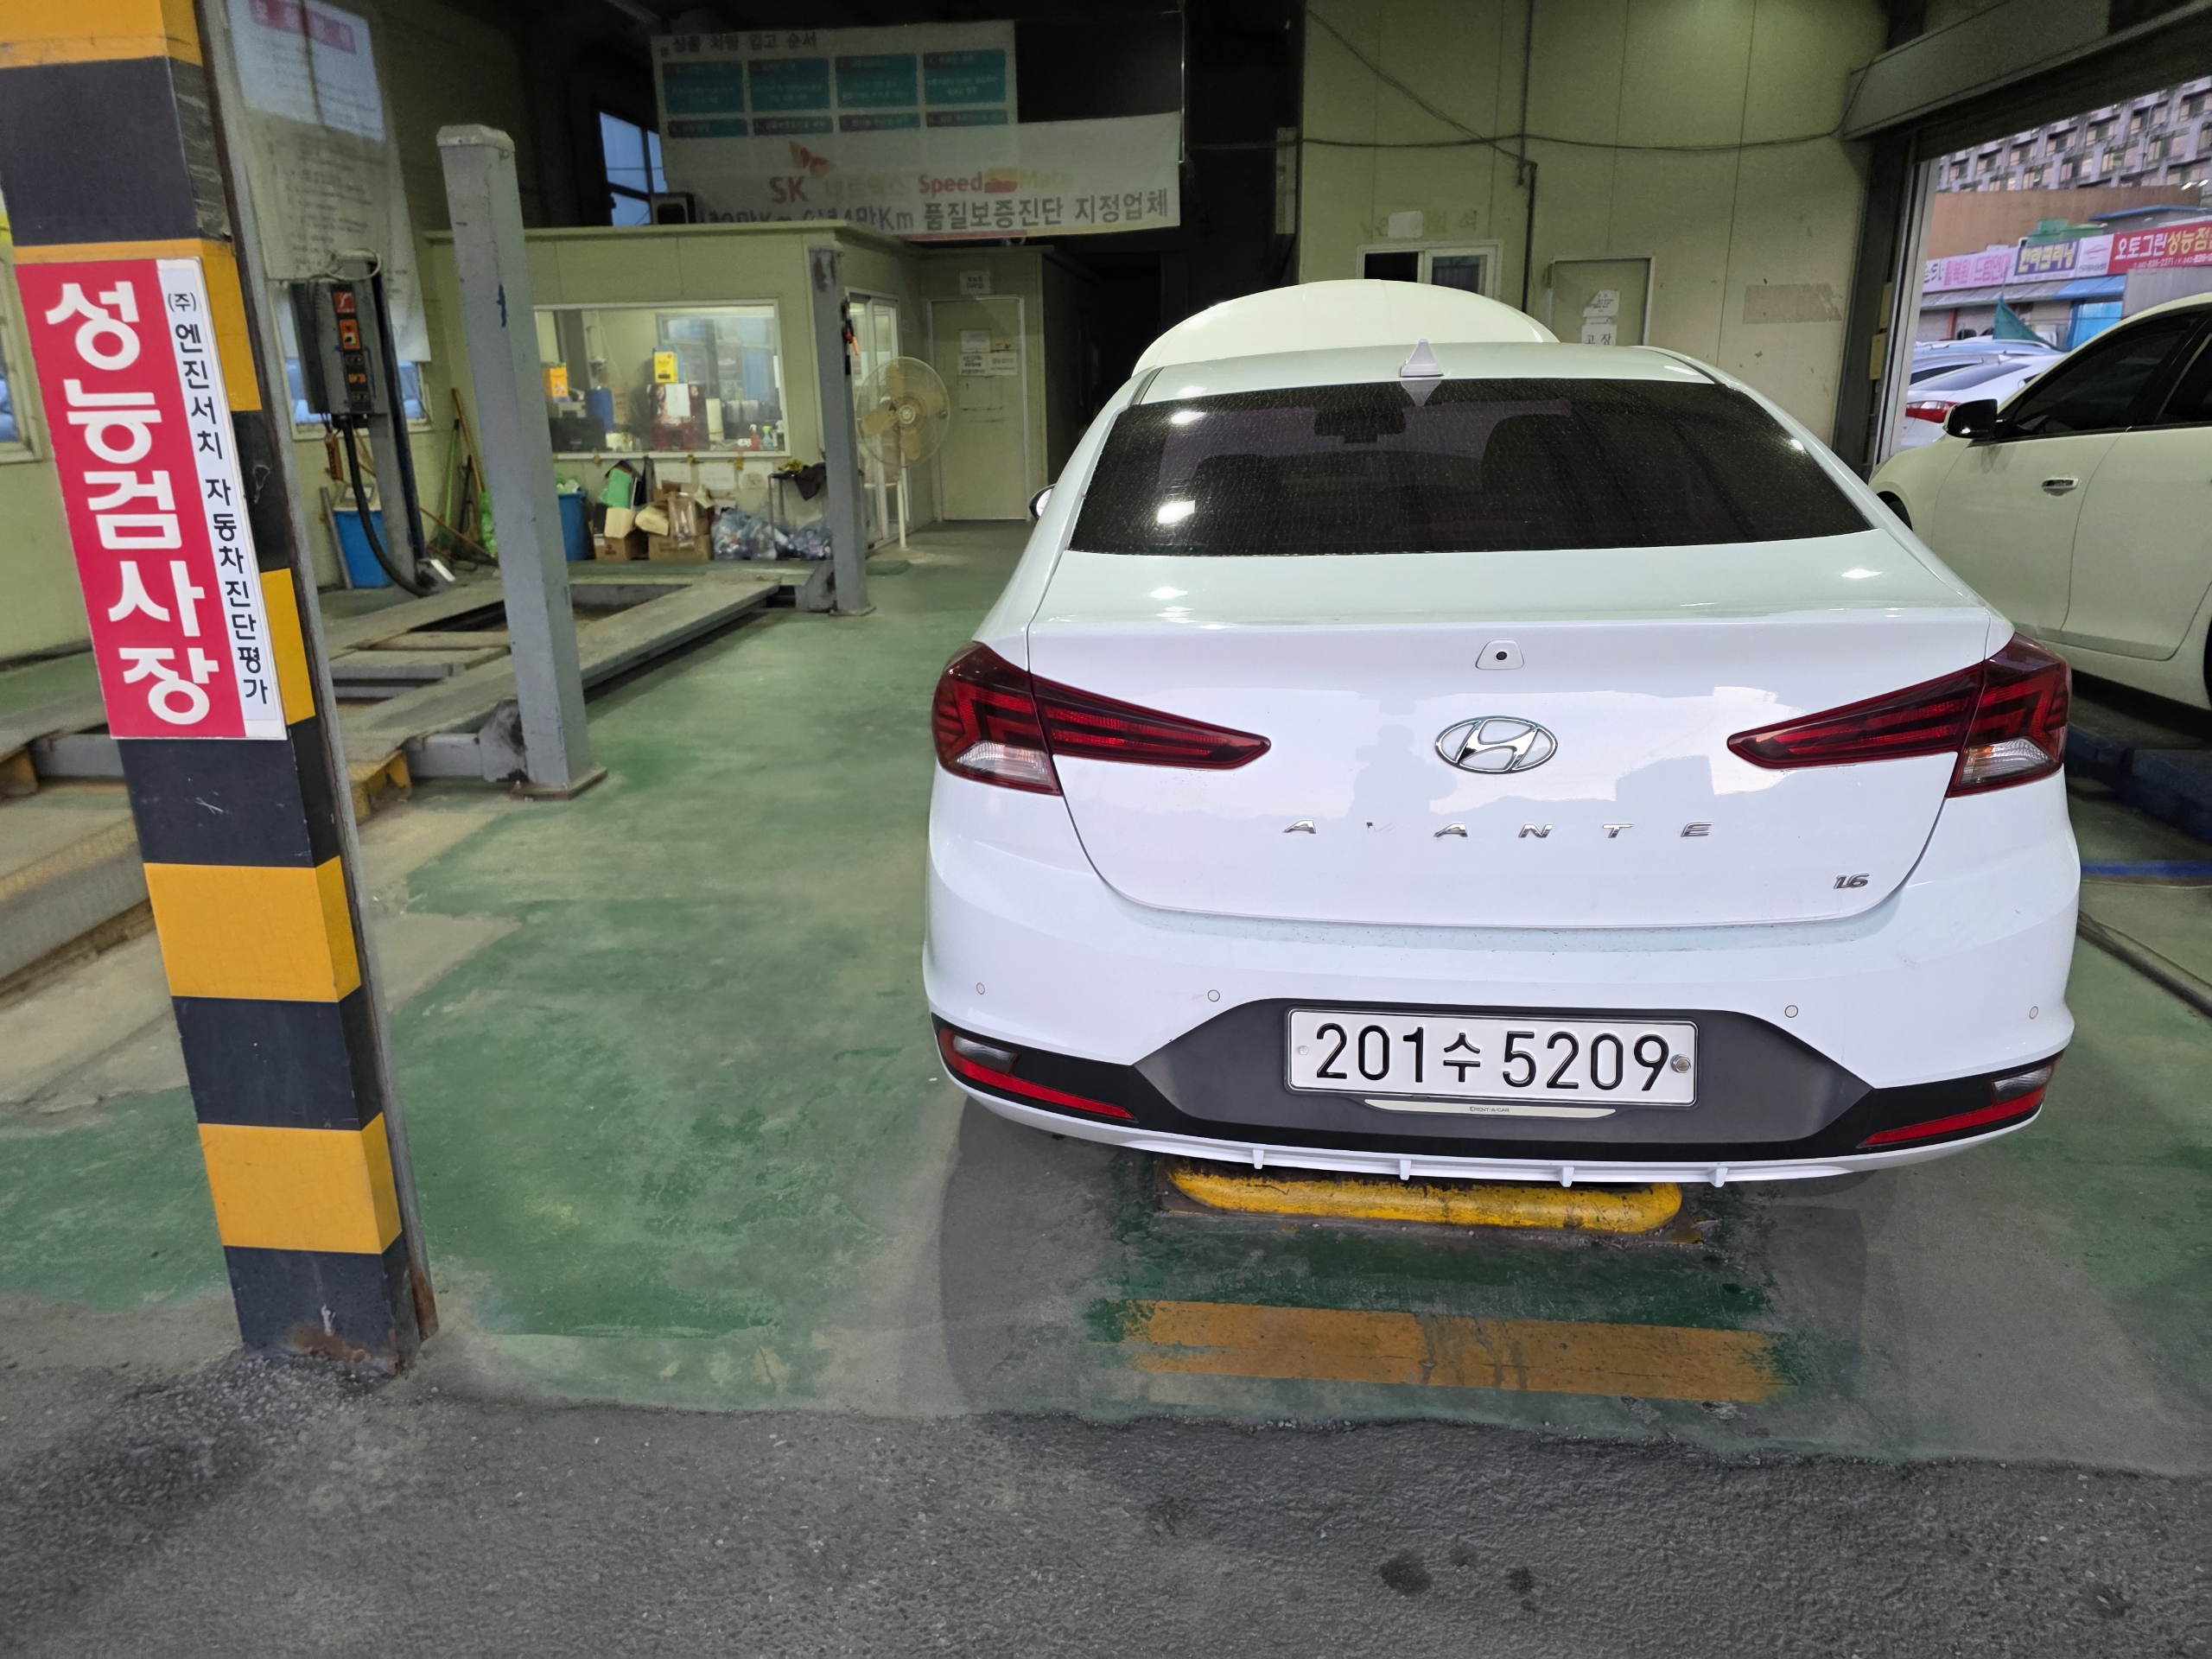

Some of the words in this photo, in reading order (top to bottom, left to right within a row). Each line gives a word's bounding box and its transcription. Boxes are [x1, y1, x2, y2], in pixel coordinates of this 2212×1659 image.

[787, 31, 817, 49] 순서
[770, 175, 809, 204] SK
[919, 172, 982, 197] Speed
[924, 197, 1064, 232] 품질보증진단
[1074, 188, 1168, 225] 지정업체
[45, 281, 220, 726] 성능검사장
[206, 478, 269, 705] 자동차진단평가
[1282, 820, 1714, 840] AANTE
[1315, 1022, 1481, 1084] 201수
[1502, 1031, 1669, 1092] 5209
